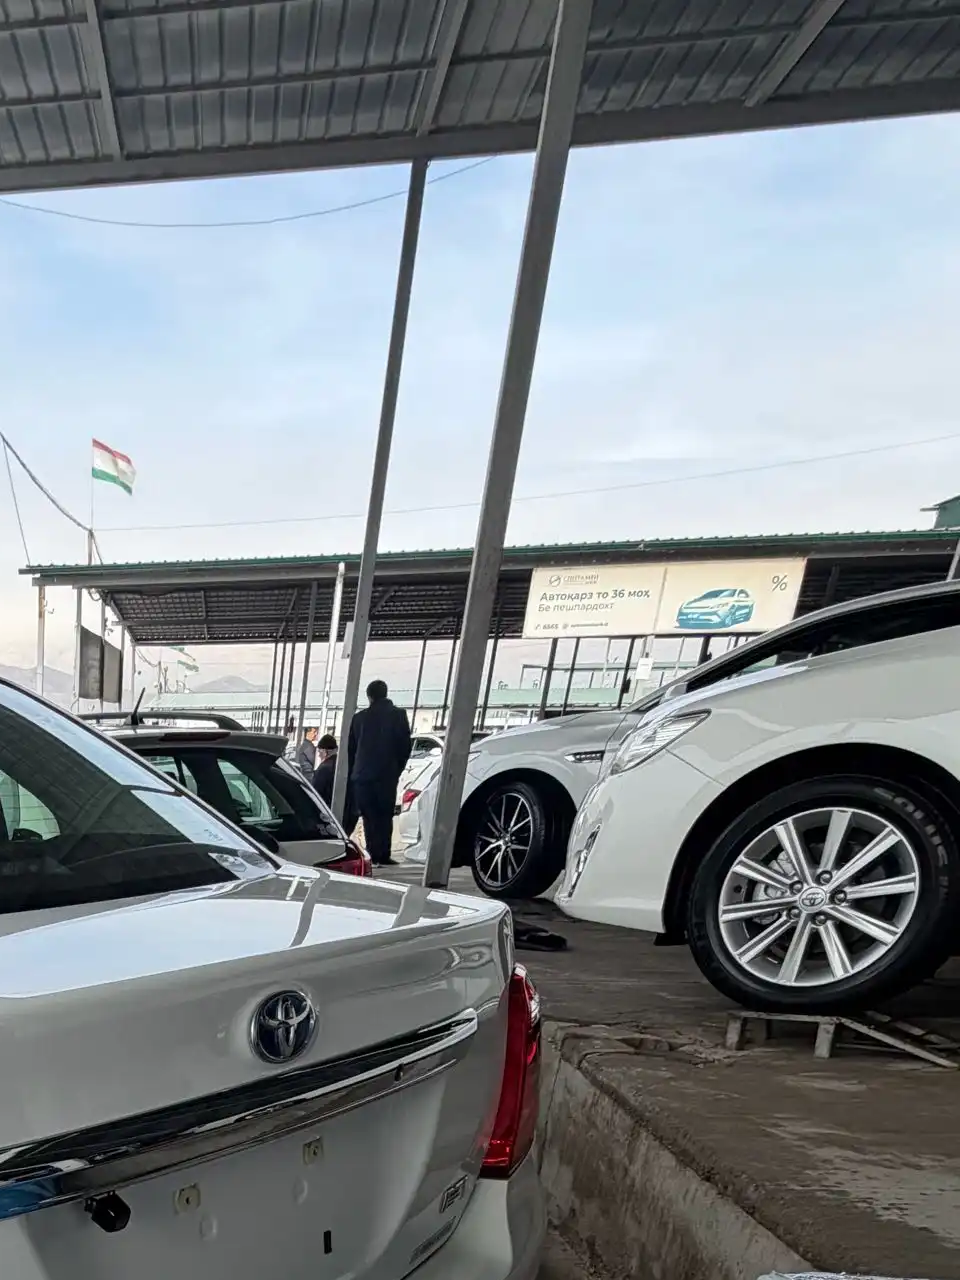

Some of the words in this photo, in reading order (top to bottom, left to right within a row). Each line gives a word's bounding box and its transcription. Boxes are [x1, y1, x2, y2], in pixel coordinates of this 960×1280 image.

[596, 591, 609, 599] то
[612, 589, 625, 598] 36
[538, 603, 551, 612] Бе
